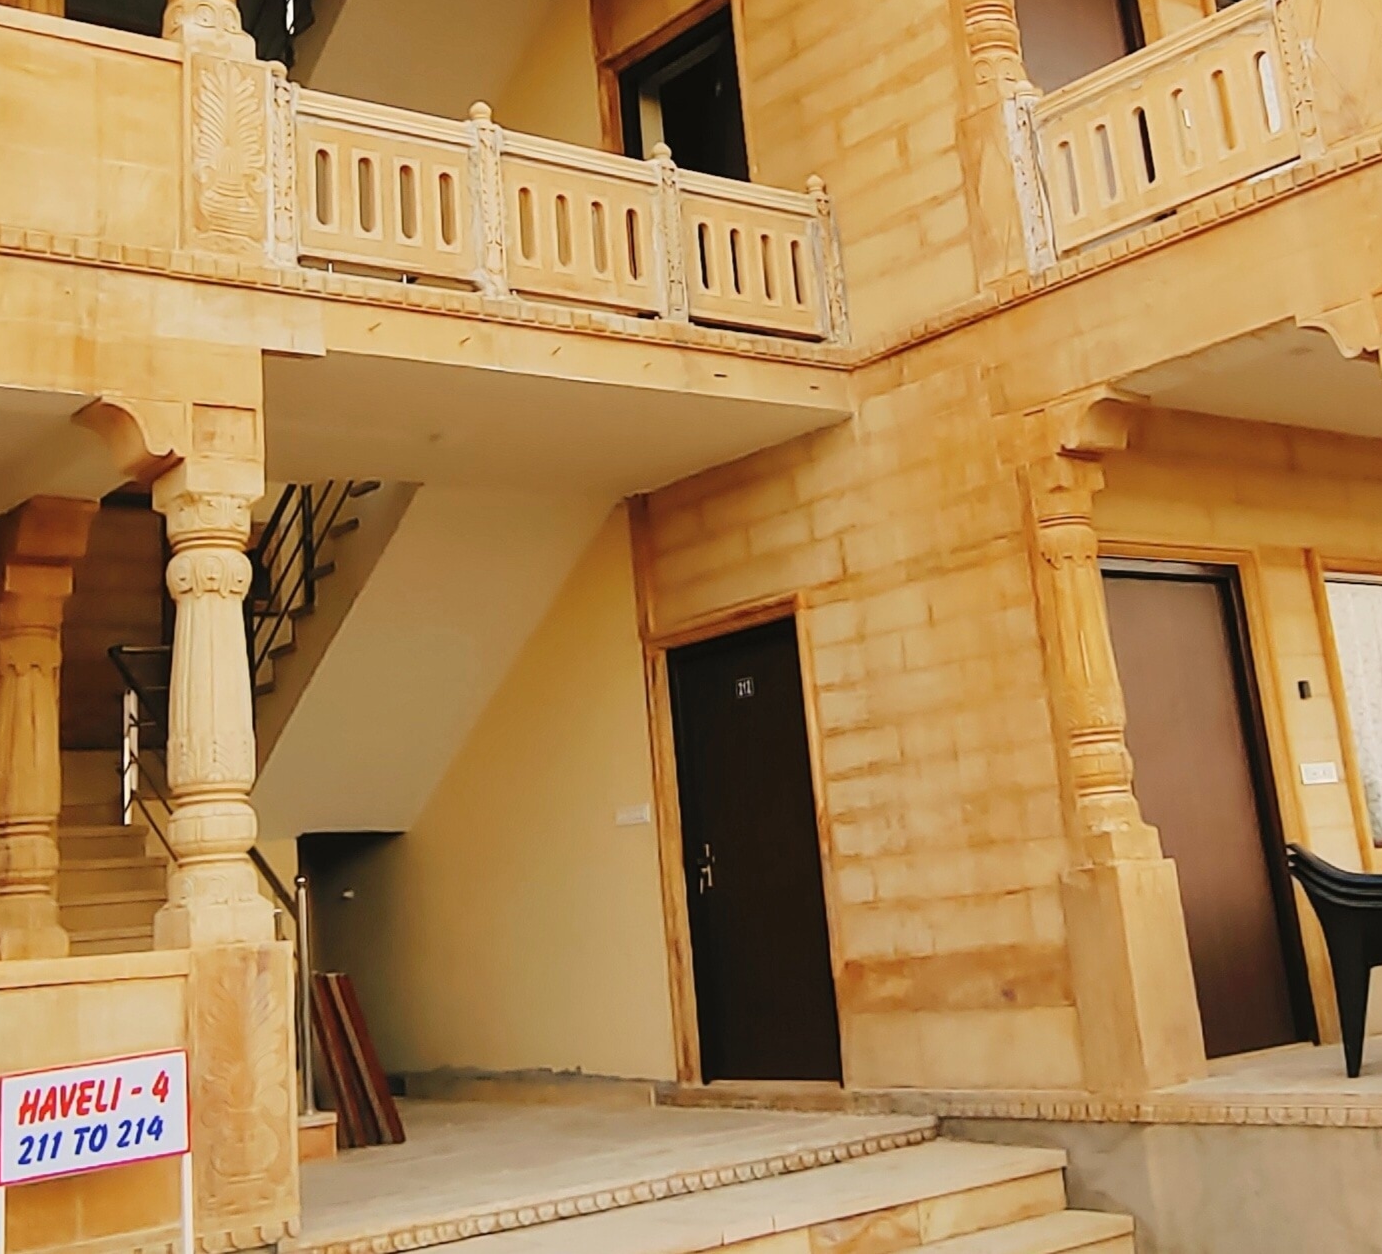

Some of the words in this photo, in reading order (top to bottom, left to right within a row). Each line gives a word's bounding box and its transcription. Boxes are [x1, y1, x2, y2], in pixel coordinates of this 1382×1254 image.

[18, 1077, 123, 1126] HAVELI
[151, 1071, 170, 1104] 4
[17, 1130, 64, 1166] 211
[73, 1123, 109, 1156] TO
[116, 1114, 165, 1149] 214
